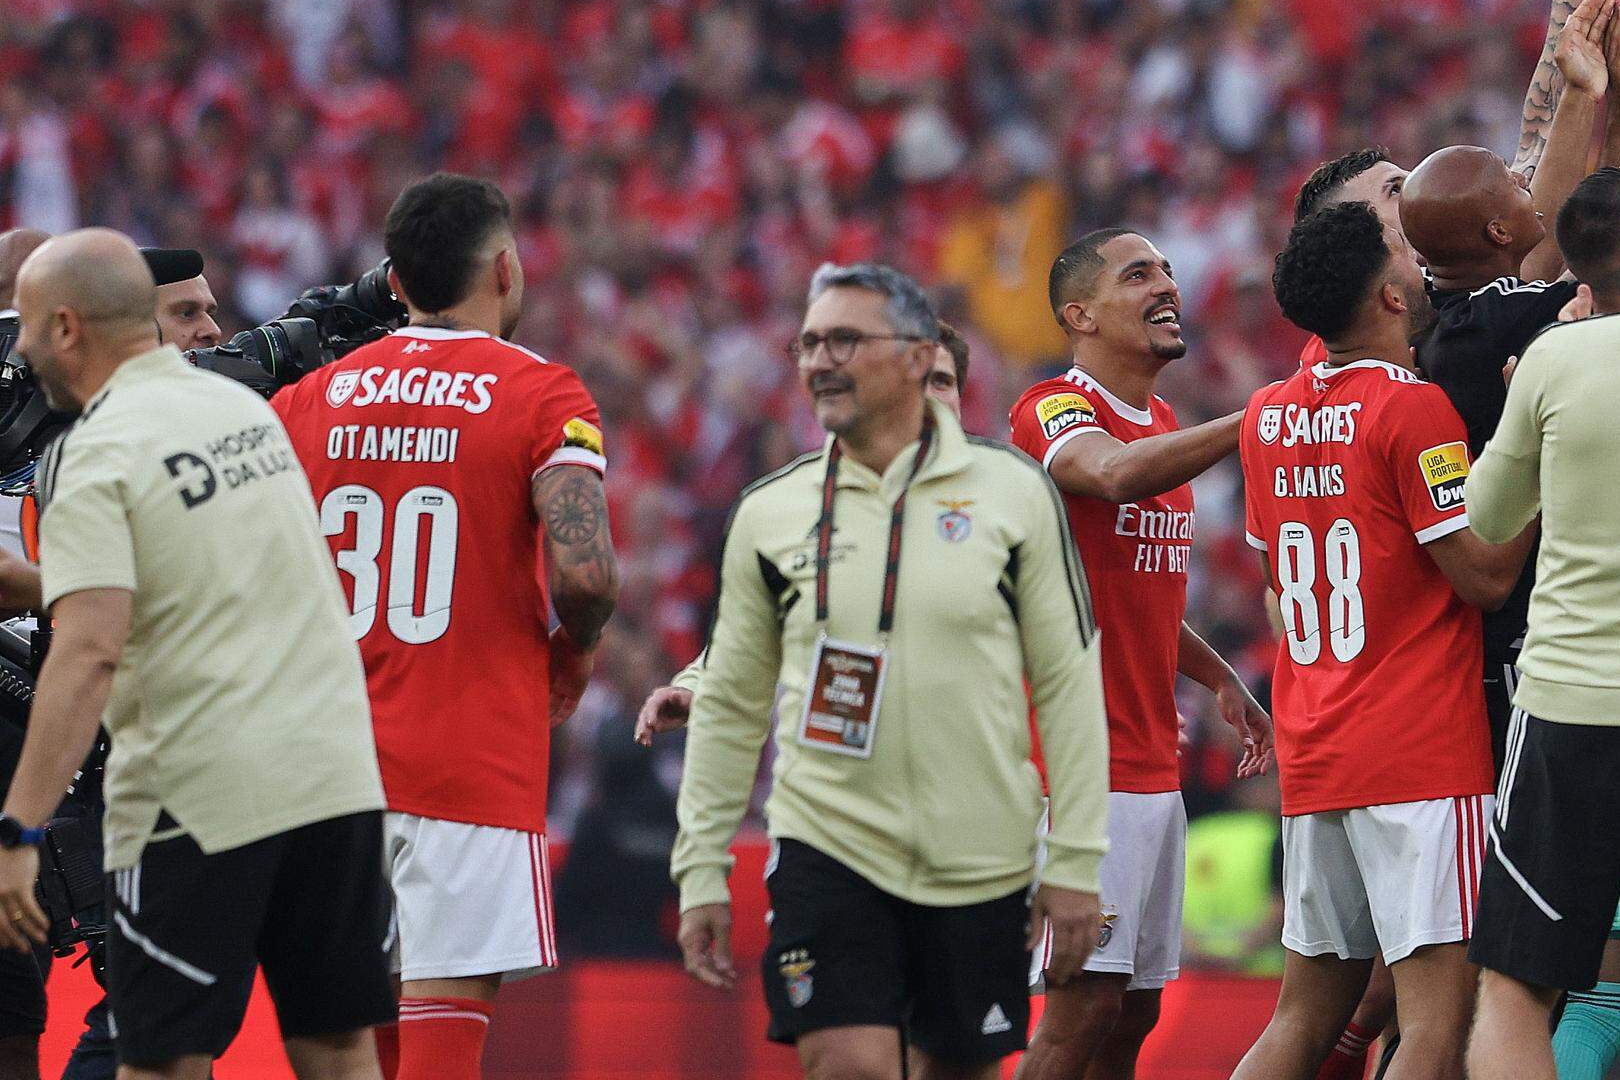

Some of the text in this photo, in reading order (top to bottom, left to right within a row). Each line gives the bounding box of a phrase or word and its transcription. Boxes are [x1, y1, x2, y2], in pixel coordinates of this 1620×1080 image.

[352, 366, 498, 414] SAGRES
[1047, 410, 1095, 436] bwin
[327, 424, 459, 463] OTAMENDI
[1426, 454, 1446, 468] LIGA
[1437, 485, 1466, 506] bw
[1115, 503, 1196, 540] Emirat
[319, 484, 459, 645] 30
[1134, 544, 1190, 573] FLY BETT
[1278, 518, 1366, 666] 88
